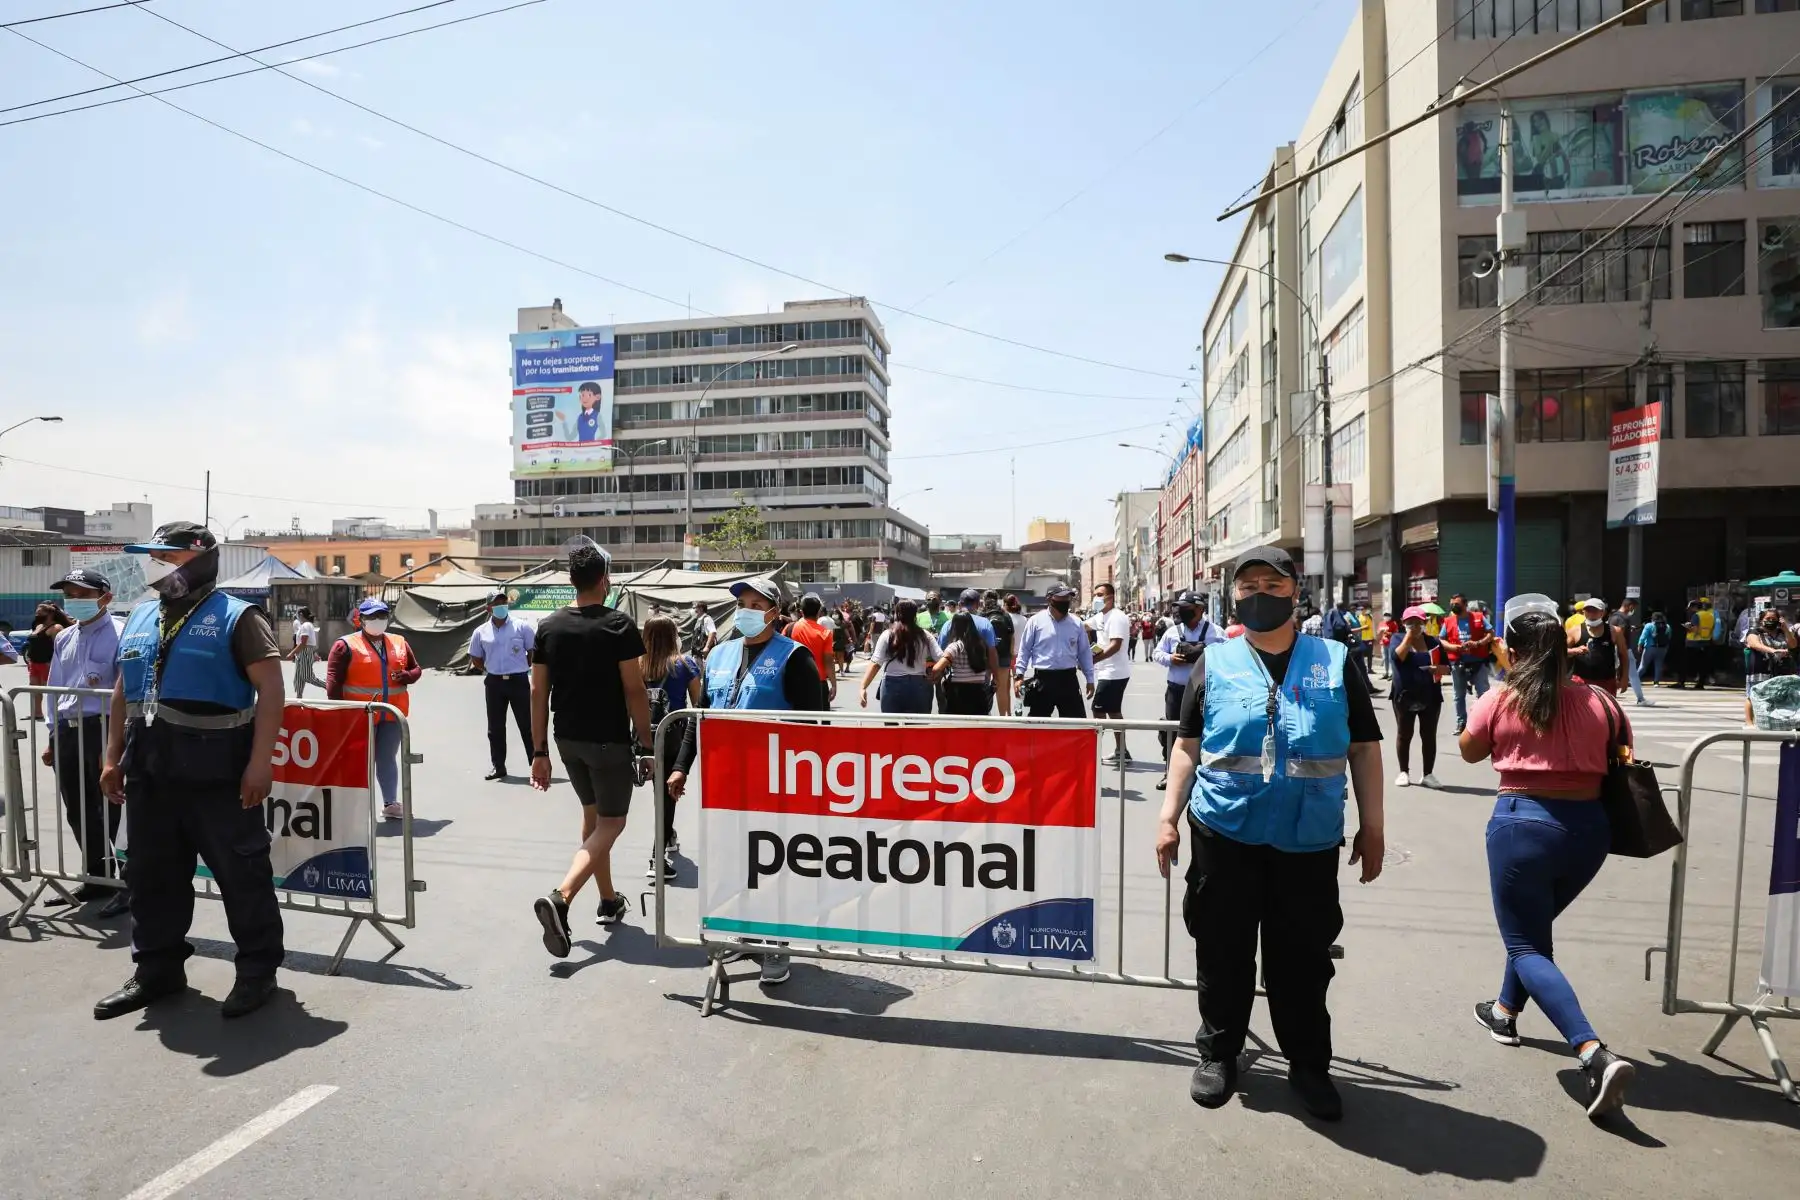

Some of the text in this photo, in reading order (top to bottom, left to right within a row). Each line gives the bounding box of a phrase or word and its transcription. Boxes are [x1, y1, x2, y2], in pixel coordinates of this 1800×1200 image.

[521, 359, 532, 367] No
[543, 357, 562, 367] dejes
[563, 354, 603, 365] sorprender
[525, 364, 599, 376] por los tramitadores
[1612, 424, 1622, 434] SE
[1611, 427, 1657, 446] JALADORES
[188, 626, 217, 638] LIMA
[768, 733, 1016, 814] Ingreso
[747, 829, 1036, 892] peatonal
[327, 876, 367, 892] LIMA
[1030, 927, 1078, 936] MUNICIPALIDAD
[1030, 935, 1088, 952] LIMA
